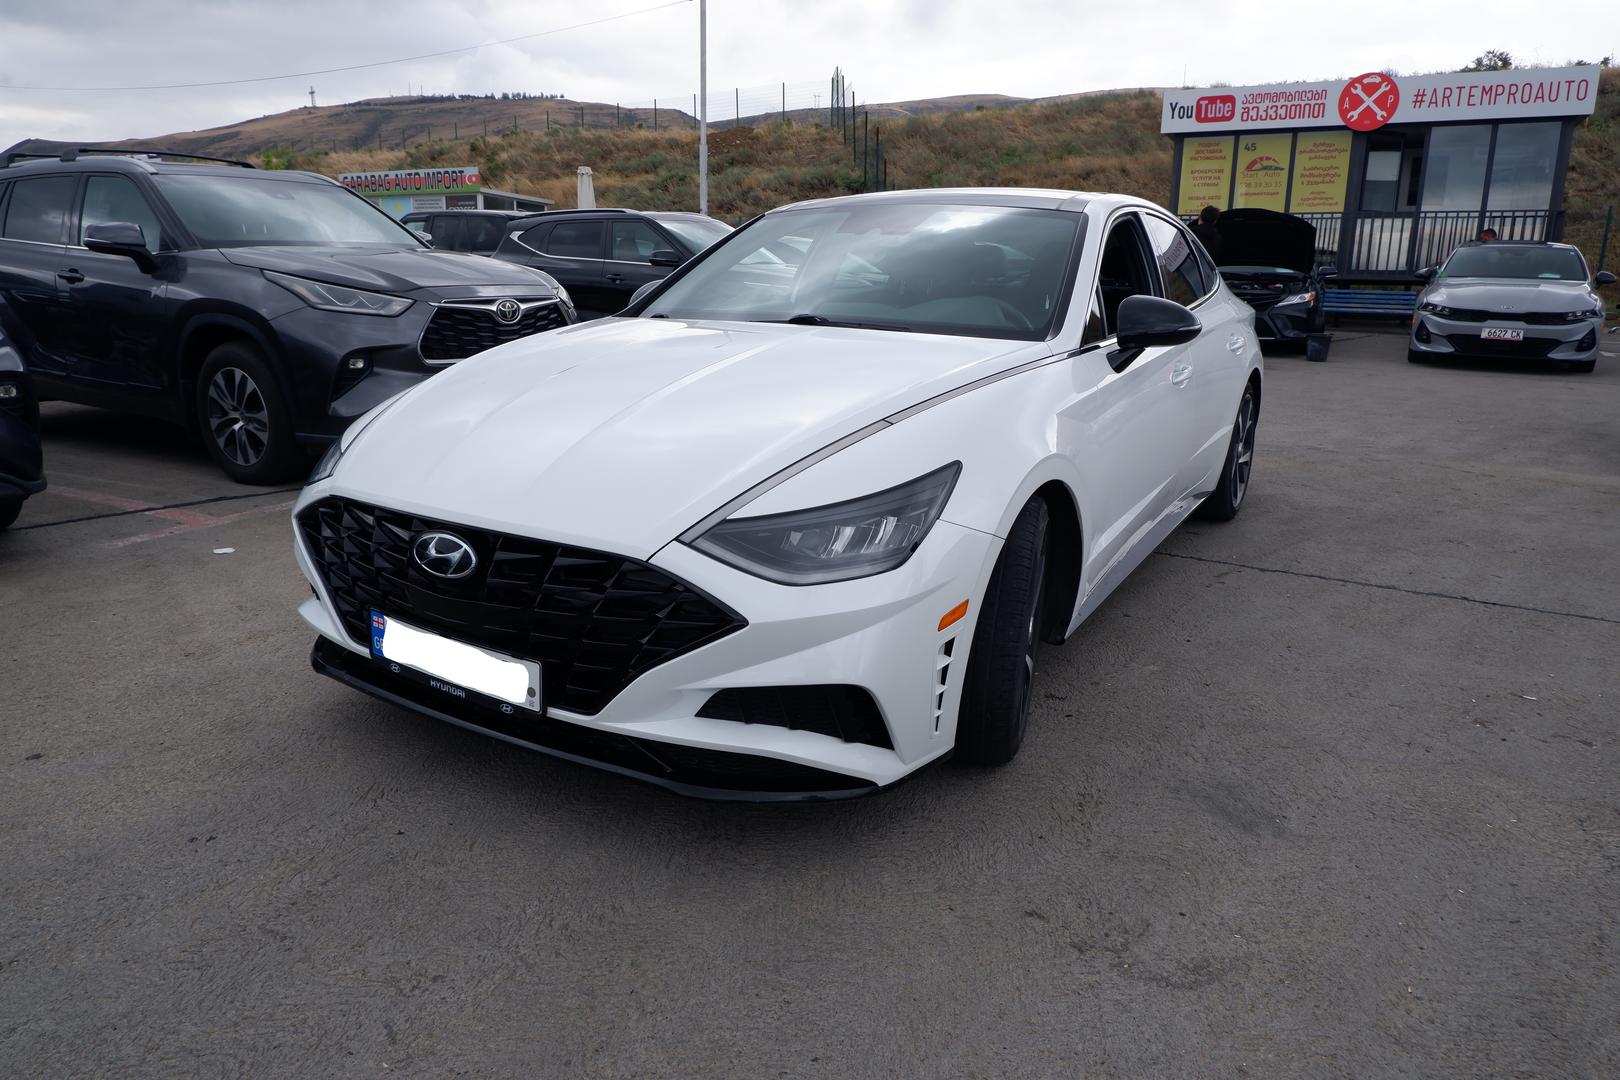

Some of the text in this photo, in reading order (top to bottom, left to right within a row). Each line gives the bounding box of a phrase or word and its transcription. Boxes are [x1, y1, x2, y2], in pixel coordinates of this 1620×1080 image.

[1242, 89, 1327, 104] ავტომობილები
[1412, 79, 1589, 109] #ARTEMPROAUTO
[1240, 102, 1326, 122] შეკვეთით
[1244, 142, 1257, 152] 45
[342, 170, 464, 193] GARABAG AUTO IMPORT
[1487, 328, 1508, 337] 6627
[430, 679, 466, 699] HYUNDAI
